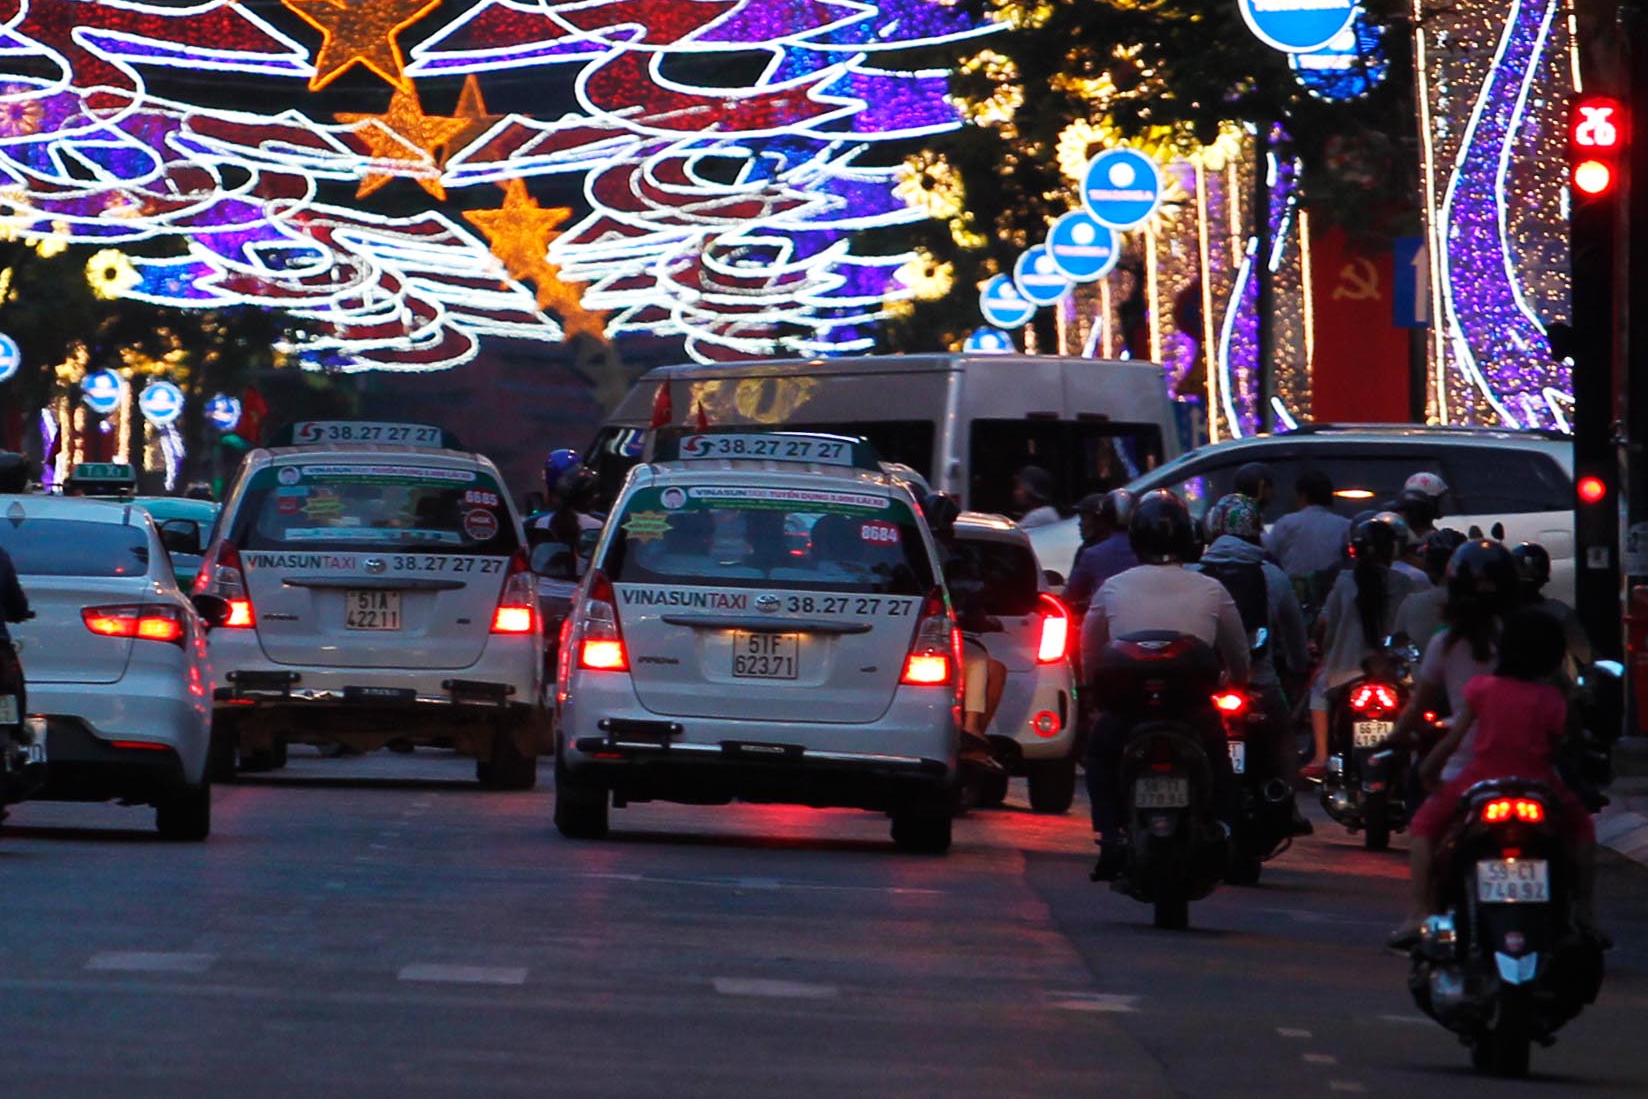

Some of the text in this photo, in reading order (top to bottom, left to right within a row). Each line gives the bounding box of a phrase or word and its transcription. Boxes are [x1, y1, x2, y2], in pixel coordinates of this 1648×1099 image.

[388, 426, 410, 441] 27
[416, 428, 438, 442] 27
[719, 439, 843, 458] 38.27 27 27
[393, 556, 447, 571] 38.27
[453, 558, 475, 572] 27
[480, 559, 503, 574] 27
[787, 596, 849, 614] 38.27
[856, 599, 882, 615] 27
[888, 600, 913, 617] 27
[748, 636, 782, 654] 51F
